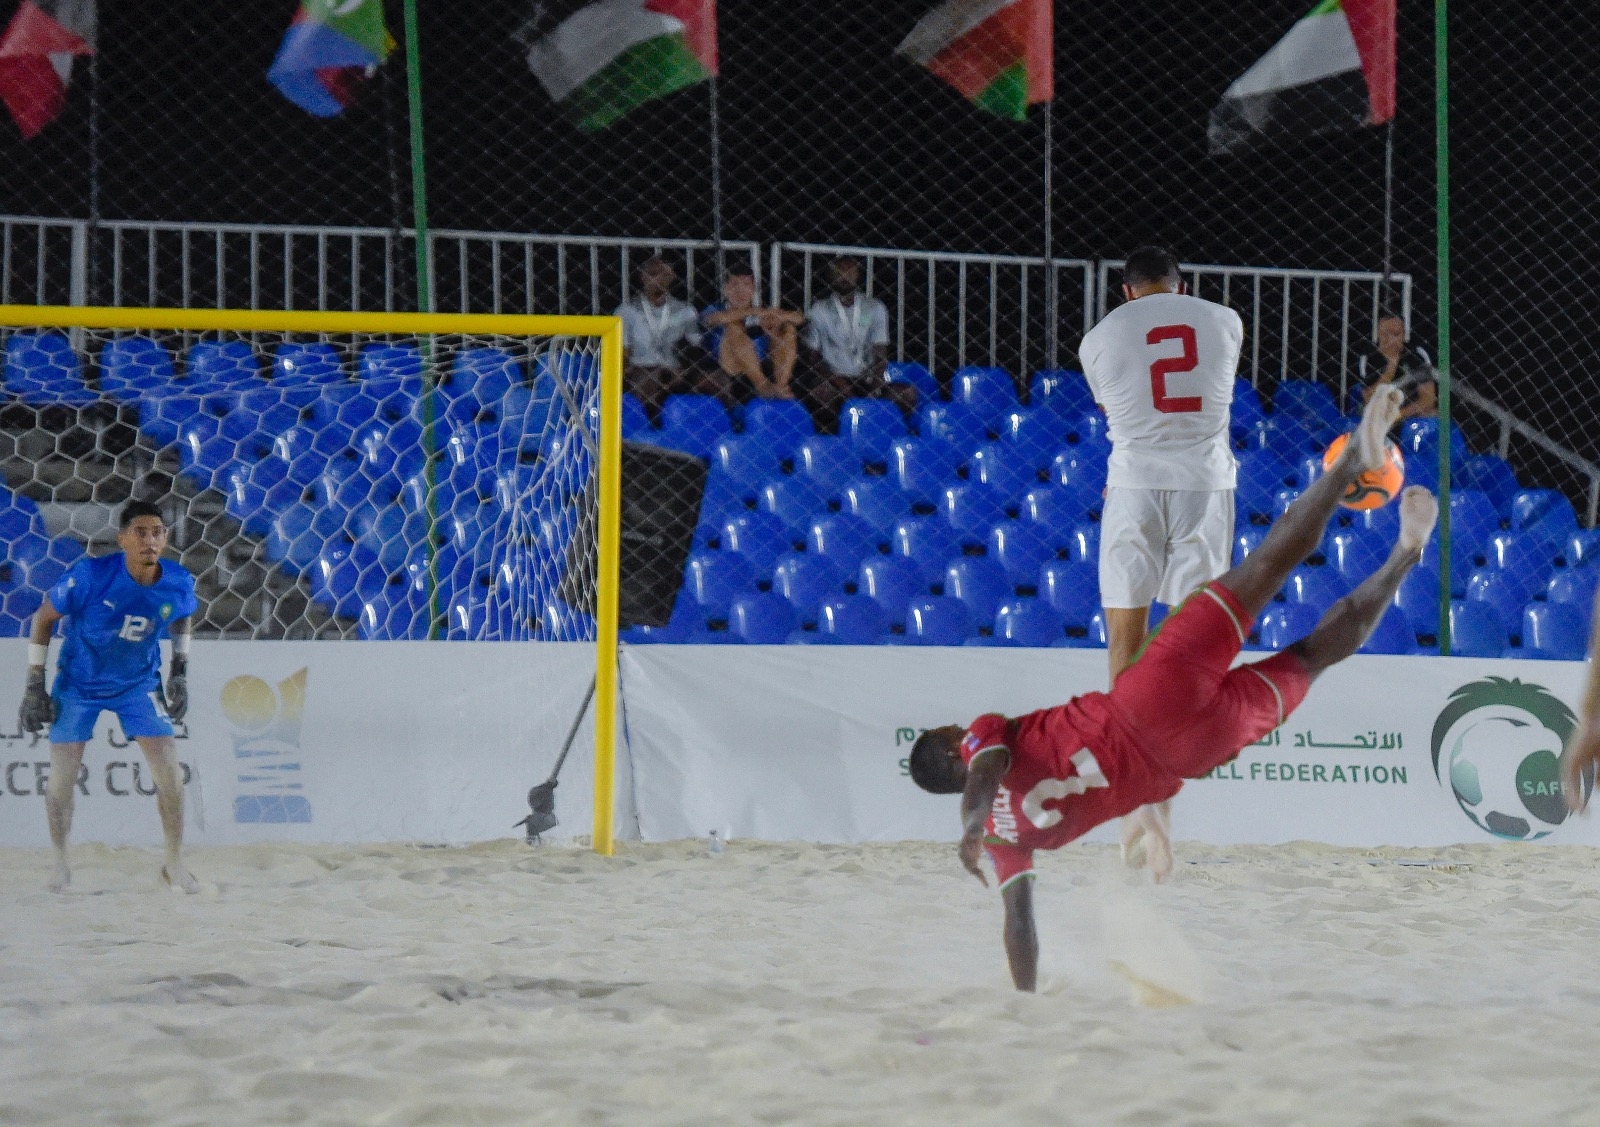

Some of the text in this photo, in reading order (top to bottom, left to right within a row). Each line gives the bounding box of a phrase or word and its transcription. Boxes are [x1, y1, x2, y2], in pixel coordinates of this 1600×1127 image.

[1145, 324, 1203, 413] 2
[118, 614, 151, 642] 12
[1294, 730, 1402, 749] الاتحاد
[0, 761, 90, 796] CER
[1021, 746, 1110, 829] 2
[1250, 763, 1408, 784] FEDERATION
